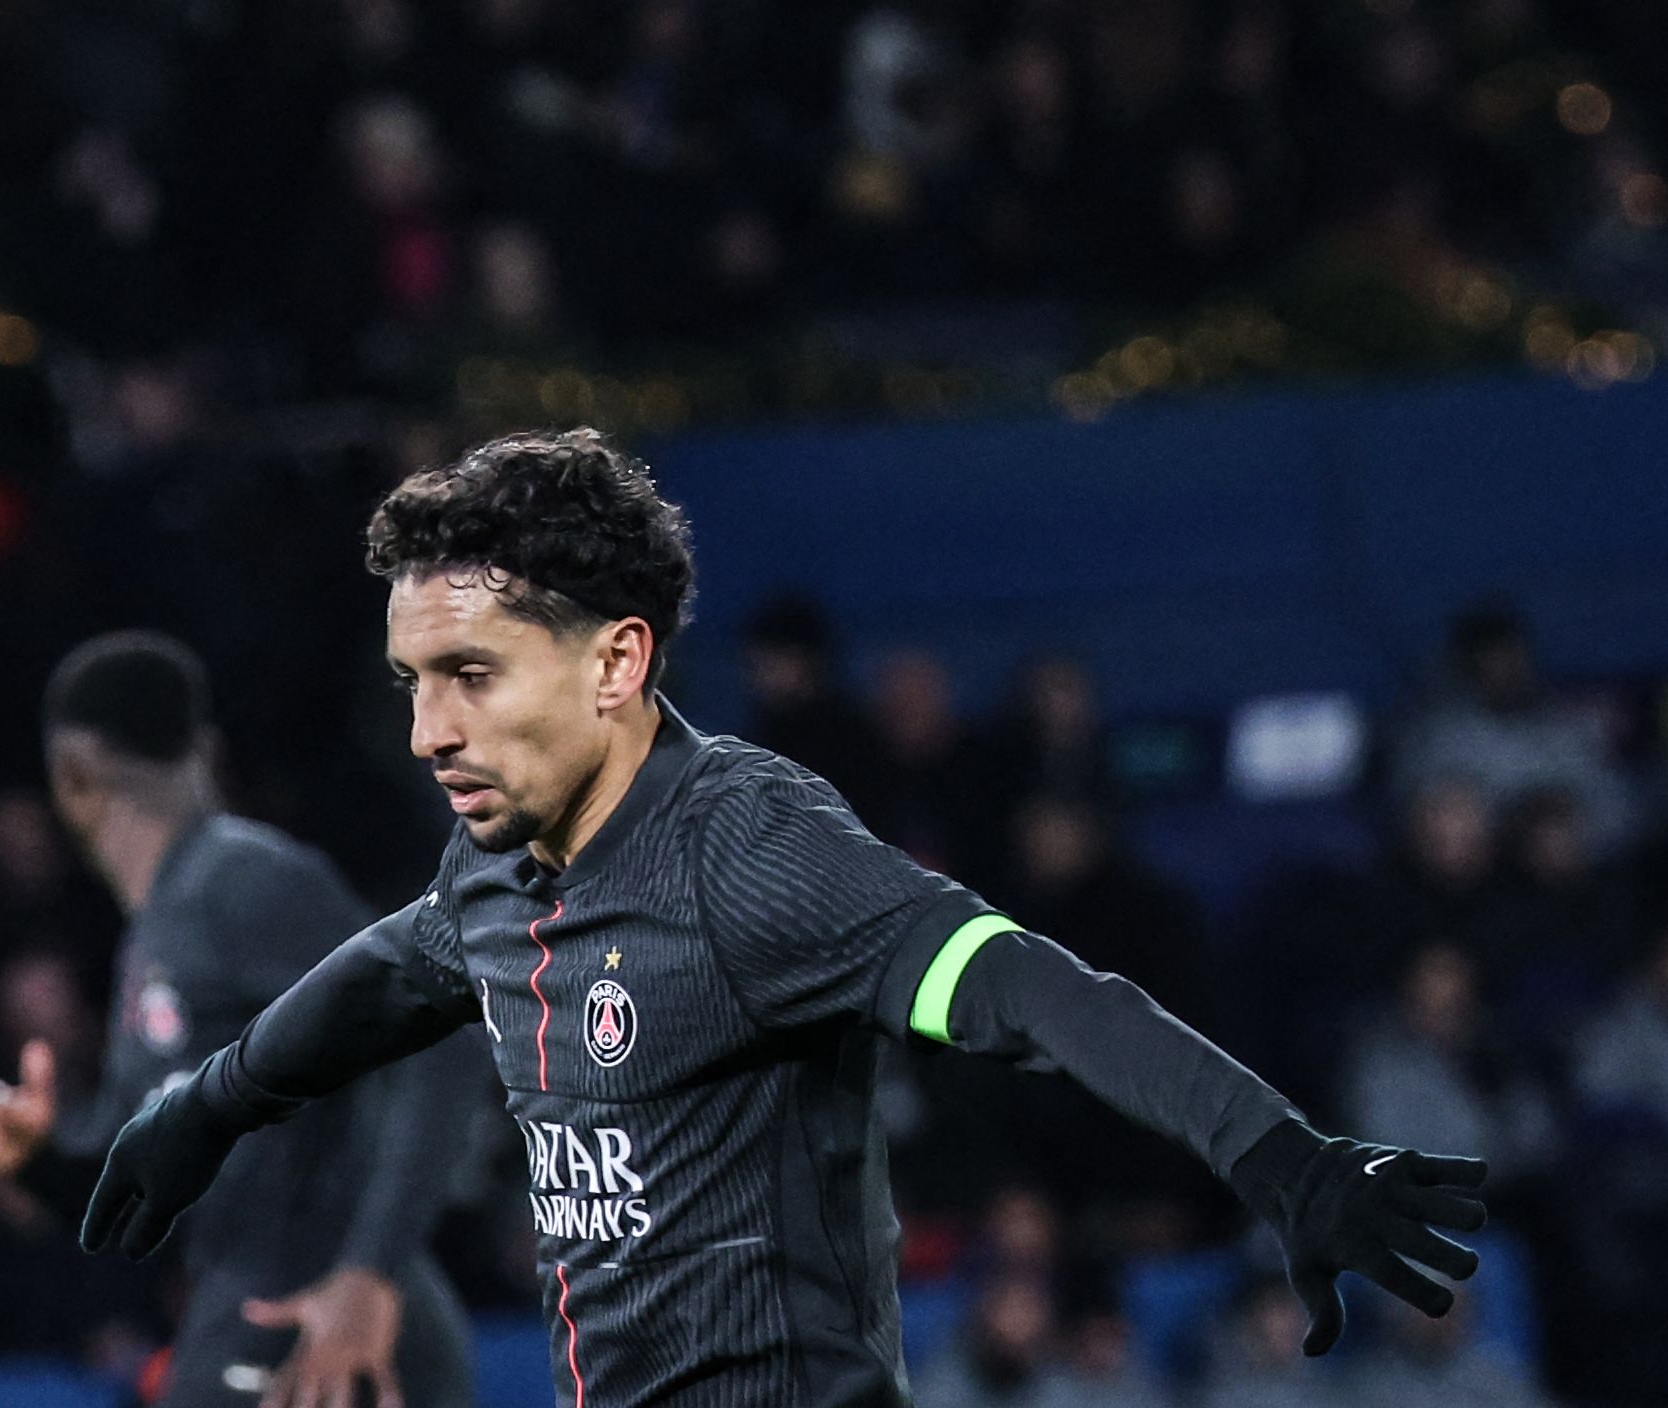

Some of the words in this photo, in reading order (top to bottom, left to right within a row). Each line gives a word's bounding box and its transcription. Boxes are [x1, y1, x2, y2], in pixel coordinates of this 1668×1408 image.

[591, 984, 626, 1007] PARIS
[513, 1114, 643, 1193] ATAR
[529, 1192, 651, 1241] AIRWAYS
